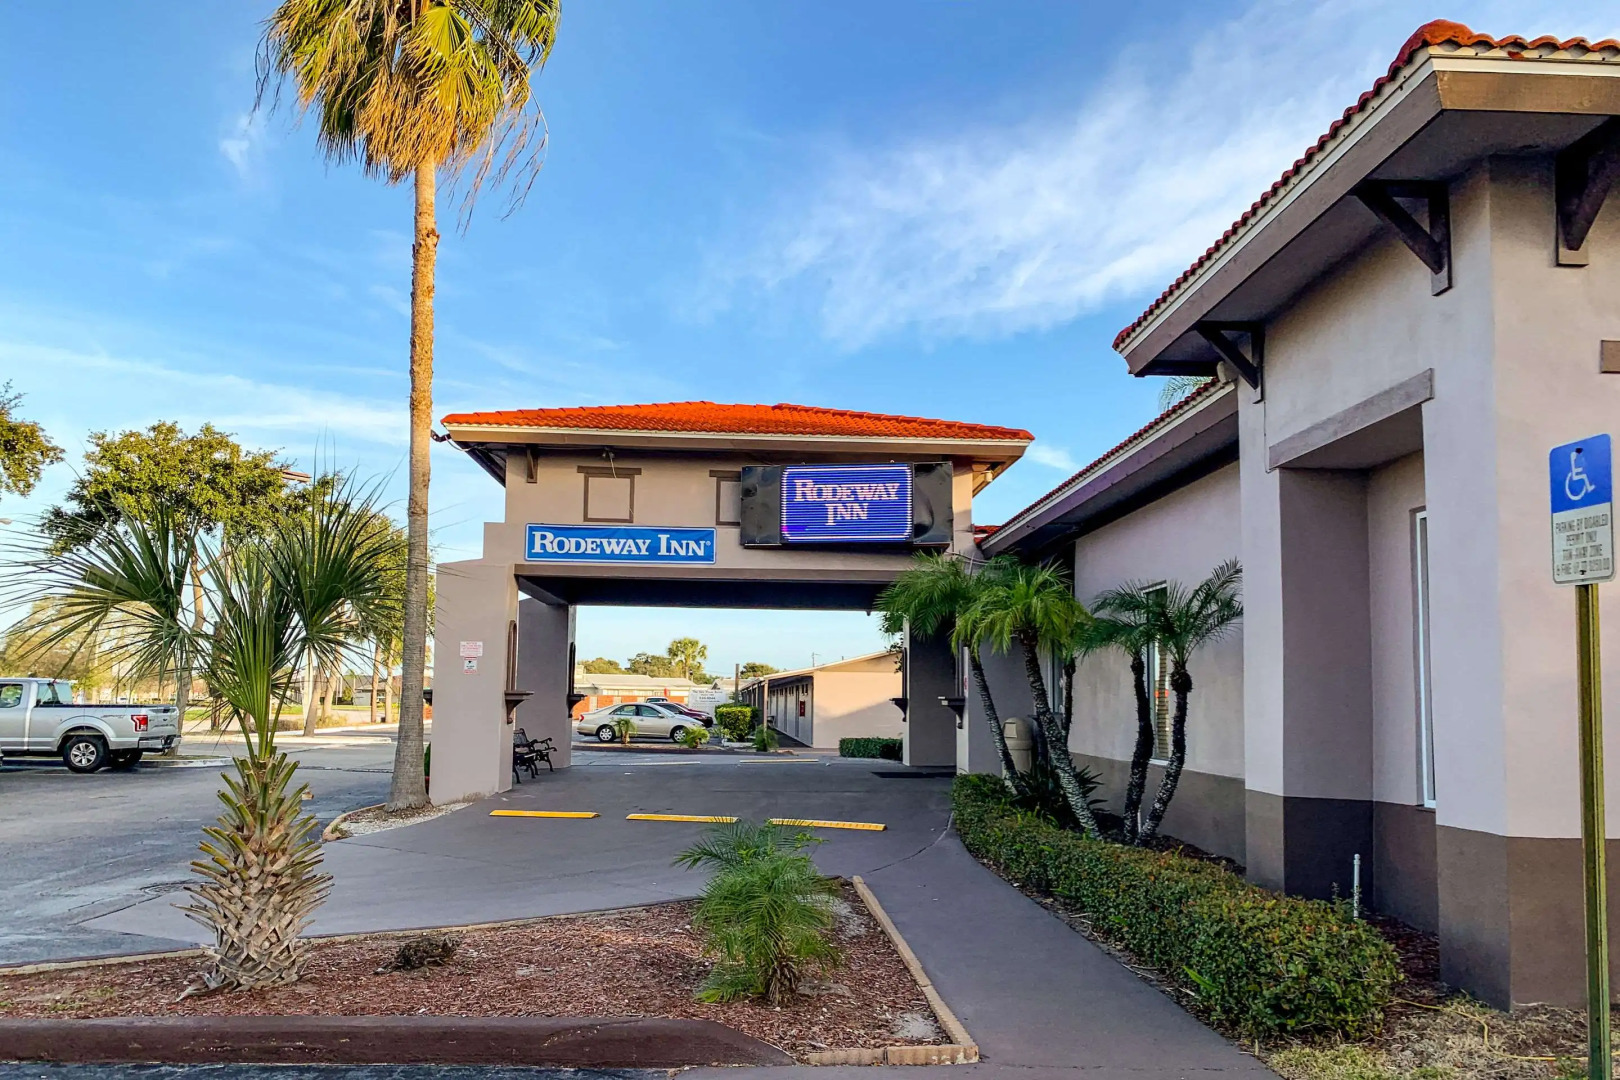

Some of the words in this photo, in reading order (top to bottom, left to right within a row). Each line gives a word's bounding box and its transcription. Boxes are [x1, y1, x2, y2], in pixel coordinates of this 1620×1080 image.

[793, 479, 900, 501] RODEWAY
[825, 503, 869, 525] INN
[1556, 520, 1574, 534] PARKING
[1577, 518, 1583, 531] BY
[1584, 514, 1608, 529] DISABLED
[531, 531, 651, 555] RODEWAY
[1566, 532, 1584, 546] PERMIT
[1586, 531, 1597, 543] ONLY
[1589, 544, 1603, 557] ZONE
